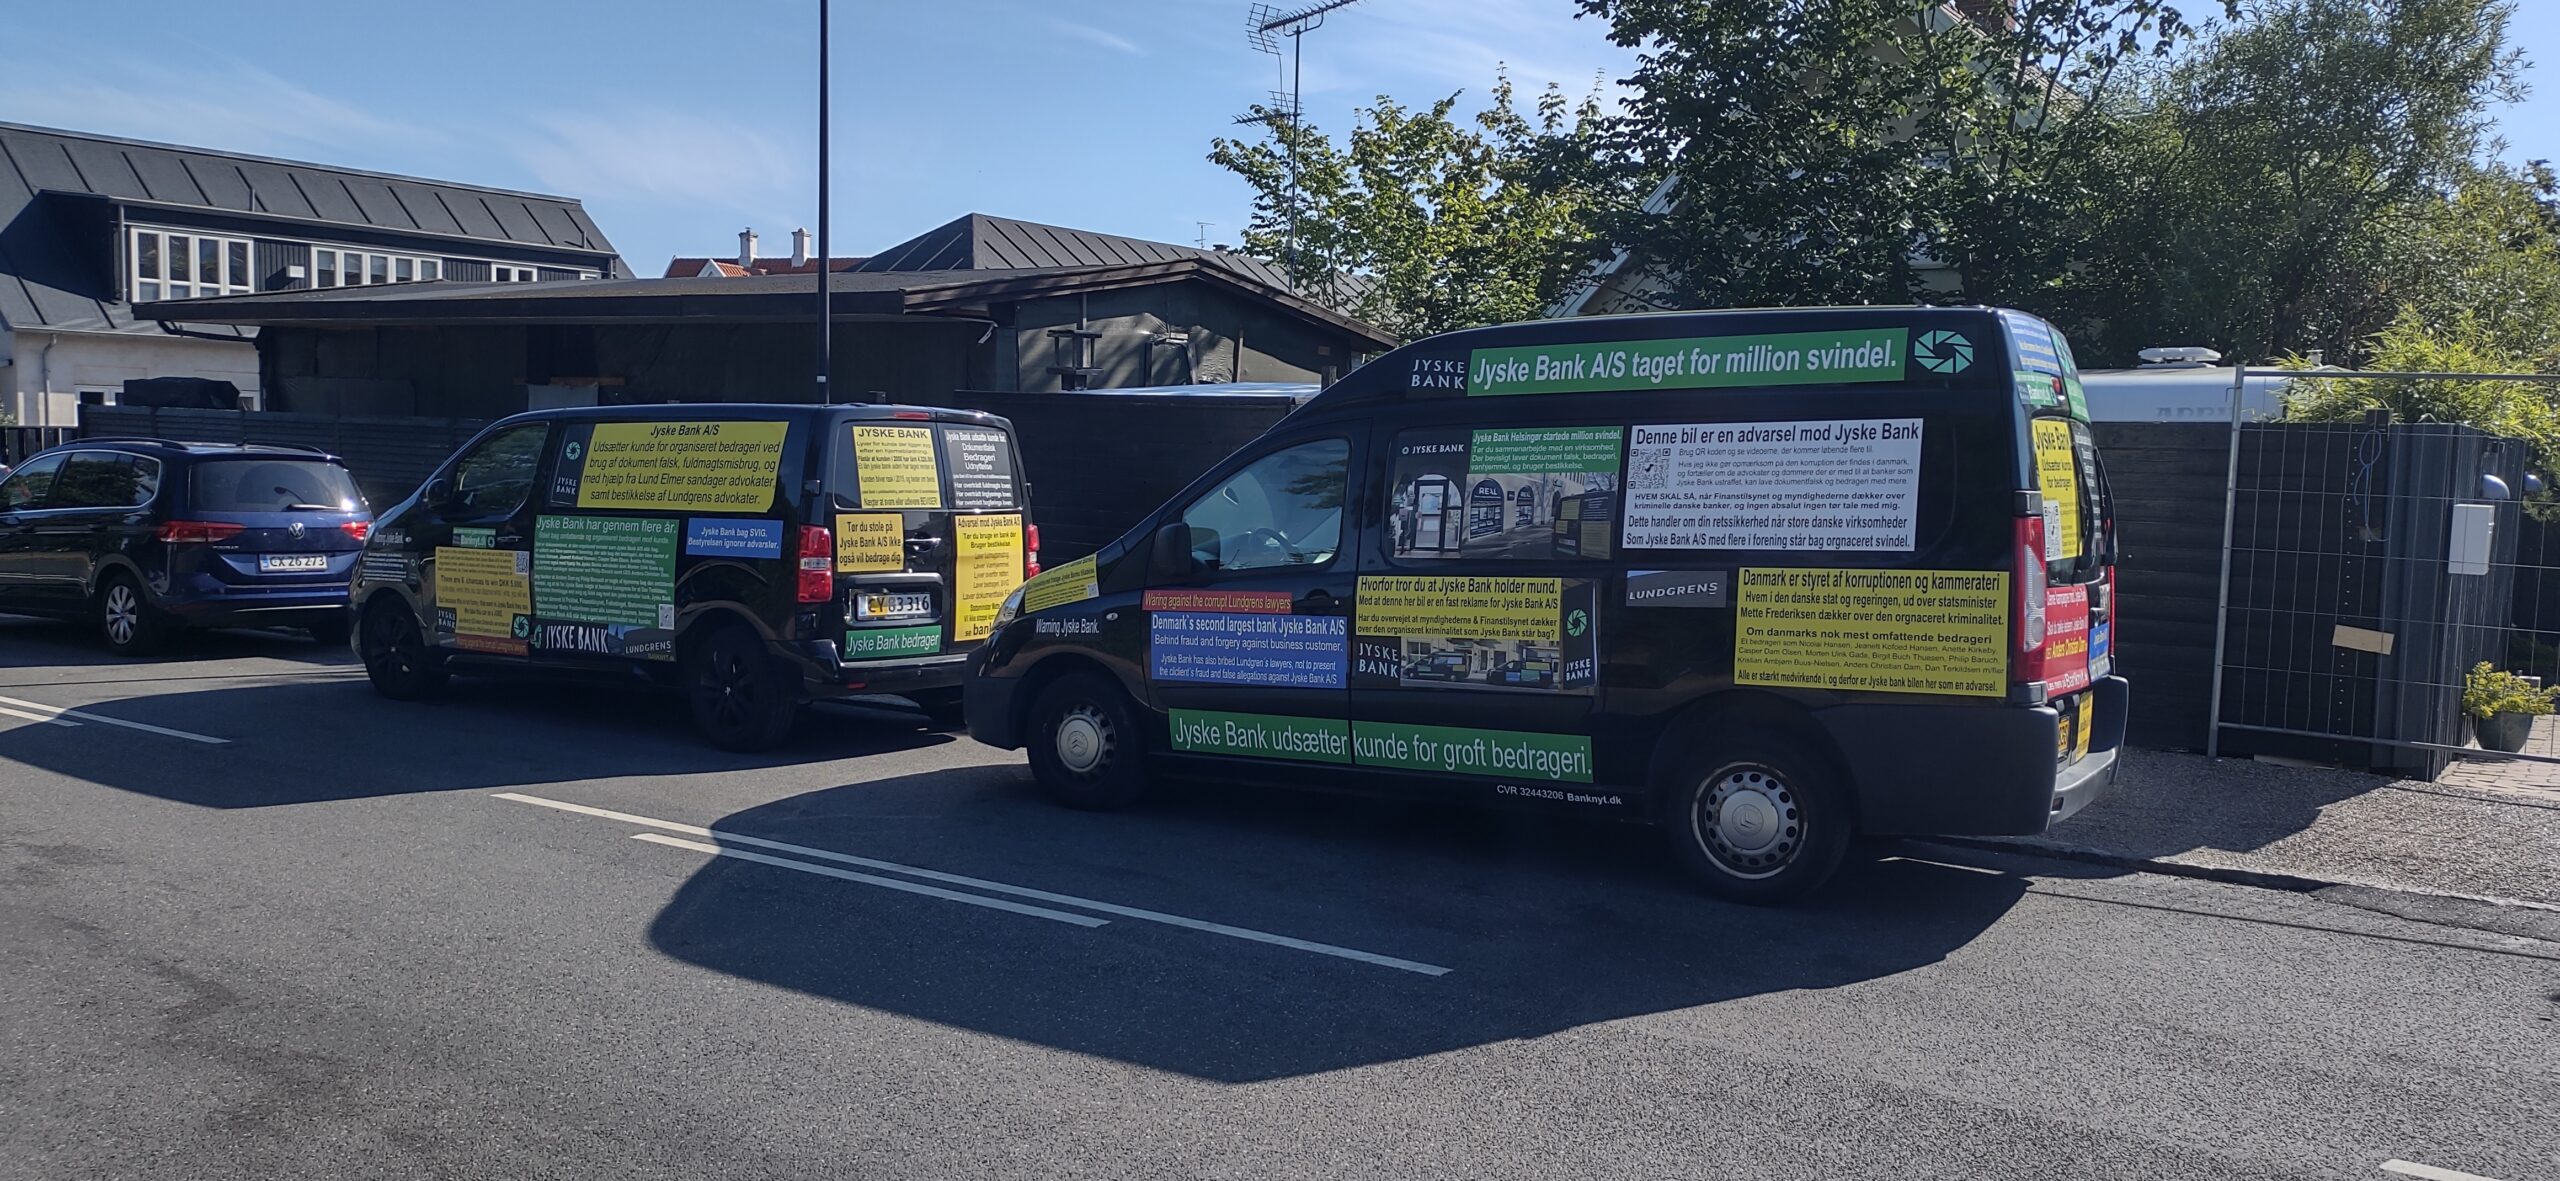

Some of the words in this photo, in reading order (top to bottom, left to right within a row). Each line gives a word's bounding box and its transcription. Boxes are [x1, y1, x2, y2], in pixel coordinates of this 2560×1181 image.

[1412, 359, 1464, 375] JYSKE
[1473, 356, 1529, 390] Jyske
[1534, 353, 1585, 380] Bank
[1589, 350, 1626, 378] A/S
[1631, 349, 1684, 383] taget
[1689, 347, 1721, 374] for
[1725, 344, 1799, 373] million
[1806, 338, 1896, 370] svindel.
[1411, 374, 1464, 389] BANK
[650, 424, 676, 437] Jyske
[677, 424, 701, 435] Bank
[702, 423, 720, 435] A/S
[858, 428, 895, 438] JYSKE
[897, 429, 928, 438] BANK
[1636, 428, 1677, 444] Denne
[1680, 427, 1697, 443] bil
[1700, 430, 1714, 443] er
[1717, 430, 1733, 443] en
[1737, 425, 1796, 442] advarsel
[1799, 424, 1831, 441] mod
[1834, 423, 1876, 443] Jyske
[1881, 422, 1918, 439] Bank
[593, 441, 629, 453] Udsætter
[629, 440, 655, 451] kunde
[656, 440, 669, 452] for
[669, 440, 717, 454] organiseret
[718, 441, 760, 456] bedrageri
[763, 441, 780, 454] ved
[1412, 444, 1436, 454] JYSKE
[1439, 444, 1464, 452] BANK
[591, 489, 610, 500] samt
[611, 488, 655, 501] bestikkelse
[656, 489, 667, 501] af
[667, 489, 712, 505] Lundgrens
[713, 490, 760, 504] advokater.
[536, 517, 560, 530] Jyske
[562, 517, 584, 529] Bank
[585, 518, 601, 529] har
[602, 521, 639, 533] gennem
[641, 521, 662, 532] flere
[663, 522, 676, 533] år.
[847, 521, 858, 532] Tør
[859, 521, 868, 532] du
[869, 521, 884, 531] stole
[885, 521, 893, 534] på
[1628, 515, 1649, 527] Dette
[1650, 515, 1681, 527] handler
[1682, 518, 1695, 527] om
[1697, 515, 1710, 527] din
[1712, 515, 1769, 527] retssikkerhed
[1771, 515, 1785, 527] når
[1787, 516, 1809, 527] store
[1811, 515, 1843, 528] danske
[1845, 515, 1907, 528] virksomheder
[839, 537, 858, 550] Jyske
[860, 538, 875, 547] Bank
[877, 538, 887, 547] A/S
[889, 538, 901, 547] ikke
[839, 553, 855, 566] også
[865, 553, 890, 565] bedrage
[1360, 578, 1393, 592] Hvorfor
[1395, 579, 1412, 593] tror
[1414, 579, 1426, 593] du
[1428, 580, 1437, 593] at
[1439, 578, 1466, 596] Jyske
[1468, 579, 1491, 593] Bank
[1494, 580, 1525, 594] holder
[1528, 580, 1557, 594] mund.
[1743, 568, 1786, 586] Danmark
[1788, 573, 1799, 586] er
[1801, 570, 1830, 590] styret
[1832, 570, 1843, 587] af
[1844, 570, 1911, 591] korruptionen
[1914, 575, 1928, 591] og
[1931, 571, 1999, 590] kammerateri
[1629, 582, 1717, 599] LUNDGRENS
[1740, 607, 1763, 618] Mette
[1765, 607, 1816, 620] Frederiksen
[1818, 609, 1851, 620] dækker
[1853, 612, 1873, 621] over
[1875, 610, 1892, 622] den
[1894, 612, 1945, 625] orgnaceret
[1947, 612, 2003, 625] kriminalitet.
[1195, 615, 1225, 631] second
[1226, 615, 1254, 636] largest
[1256, 616, 1277, 633] bank
[1278, 617, 1303, 637] Jyske
[1305, 618, 1327, 634] Bank
[1328, 618, 1344, 635] A/S
[546, 625, 574, 648] JYSKE
[577, 625, 609, 653] BANK
[846, 636, 874, 655] Jyske
[876, 635, 900, 650] Bank
[901, 633, 939, 651] bedrager
[1154, 633, 1179, 648] Behind
[1180, 634, 1198, 646] fraud
[1199, 635, 1213, 646] and
[1214, 635, 1240, 650] forgery
[1241, 637, 1269, 650] against
[1270, 638, 1303, 650] business
[1304, 640, 1342, 654] customer.
[1746, 627, 1764, 636] Om
[1767, 627, 1817, 638] danmarks
[1821, 629, 1840, 639] nok
[1843, 631, 1869, 640] mest
[1871, 631, 1934, 642] omfattende
[1937, 633, 1992, 646] bedrageri
[625, 640, 671, 654] LUNDGRENS
[1359, 642, 1398, 661] JYSKE
[1359, 658, 1398, 678] BANK
[1175, 717, 1220, 747] Jyske
[1224, 720, 1268, 749] Bank
[1271, 725, 1347, 755] udsætter
[1352, 730, 1407, 759] kunde
[1412, 734, 1437, 762] for
[1443, 738, 1486, 768] groft
[1491, 739, 1591, 778] bedrageri.
[1496, 784, 1517, 795] CVR
[1519, 787, 1563, 799] 32443206
